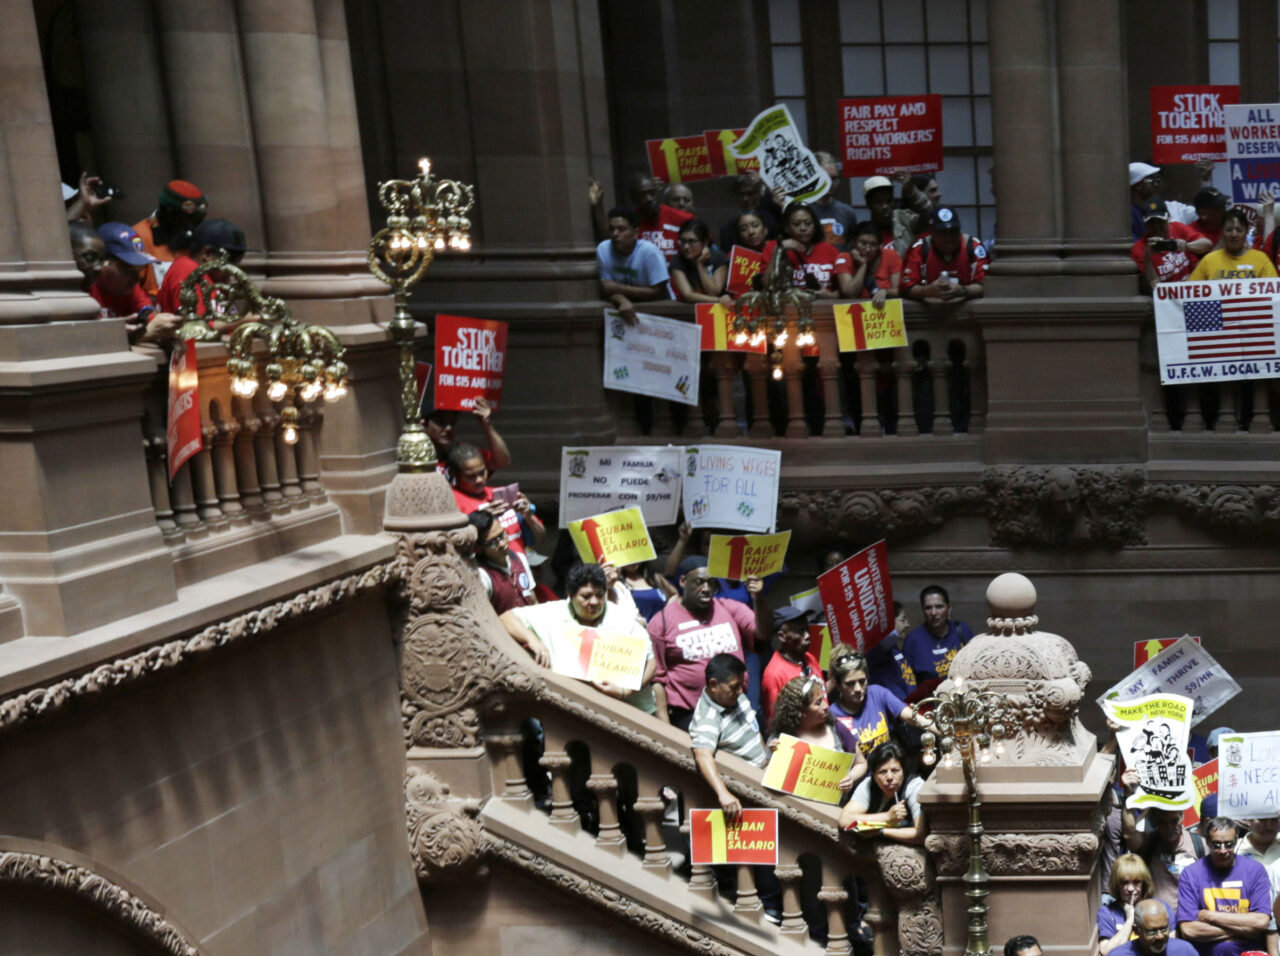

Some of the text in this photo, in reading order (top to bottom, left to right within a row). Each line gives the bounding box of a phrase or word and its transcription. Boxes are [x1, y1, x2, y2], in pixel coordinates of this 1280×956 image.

[844, 103, 926, 119] FAIR PAY AND
[1174, 94, 1220, 113] STICK
[1247, 109, 1275, 124] ALL
[845, 118, 898, 133] RESPECT
[846, 131, 871, 146] FOR
[847, 147, 891, 161] RIGHTS
[1232, 163, 1243, 180] A
[1156, 284, 1213, 300] UNITED
[1218, 282, 1243, 297] WE
[864, 312, 886, 323] LOW
[457, 328, 497, 351] STICK
[442, 346, 503, 373] TOGETHER
[1167, 366, 1218, 380] U.F.C.W.
[1221, 362, 1261, 377] LOCAL
[439, 374, 487, 389] FOR $15 AND
[700, 455, 777, 477] LIVING WAGES
[593, 476, 649, 486] NO PUEDE
[600, 522, 634, 538] SUBAN
[602, 536, 616, 546] EL
[605, 537, 649, 555] SALARIO
[744, 543, 781, 557] RAISE
[744, 555, 768, 565] THE
[855, 567, 880, 632] UNIDOS
[592, 657, 641, 677] SALARIO
[1128, 647, 1186, 696] MY FAMILY
[1166, 658, 1200, 686] THRIVE
[1119, 701, 1187, 717] MAKE THE ROAD
[803, 766, 816, 776] EL
[806, 755, 842, 773] SUBAN
[1229, 790, 1249, 809] UN
[727, 821, 765, 832] SUBAN
[727, 831, 741, 841] EL
[727, 840, 775, 850] SALARIO
